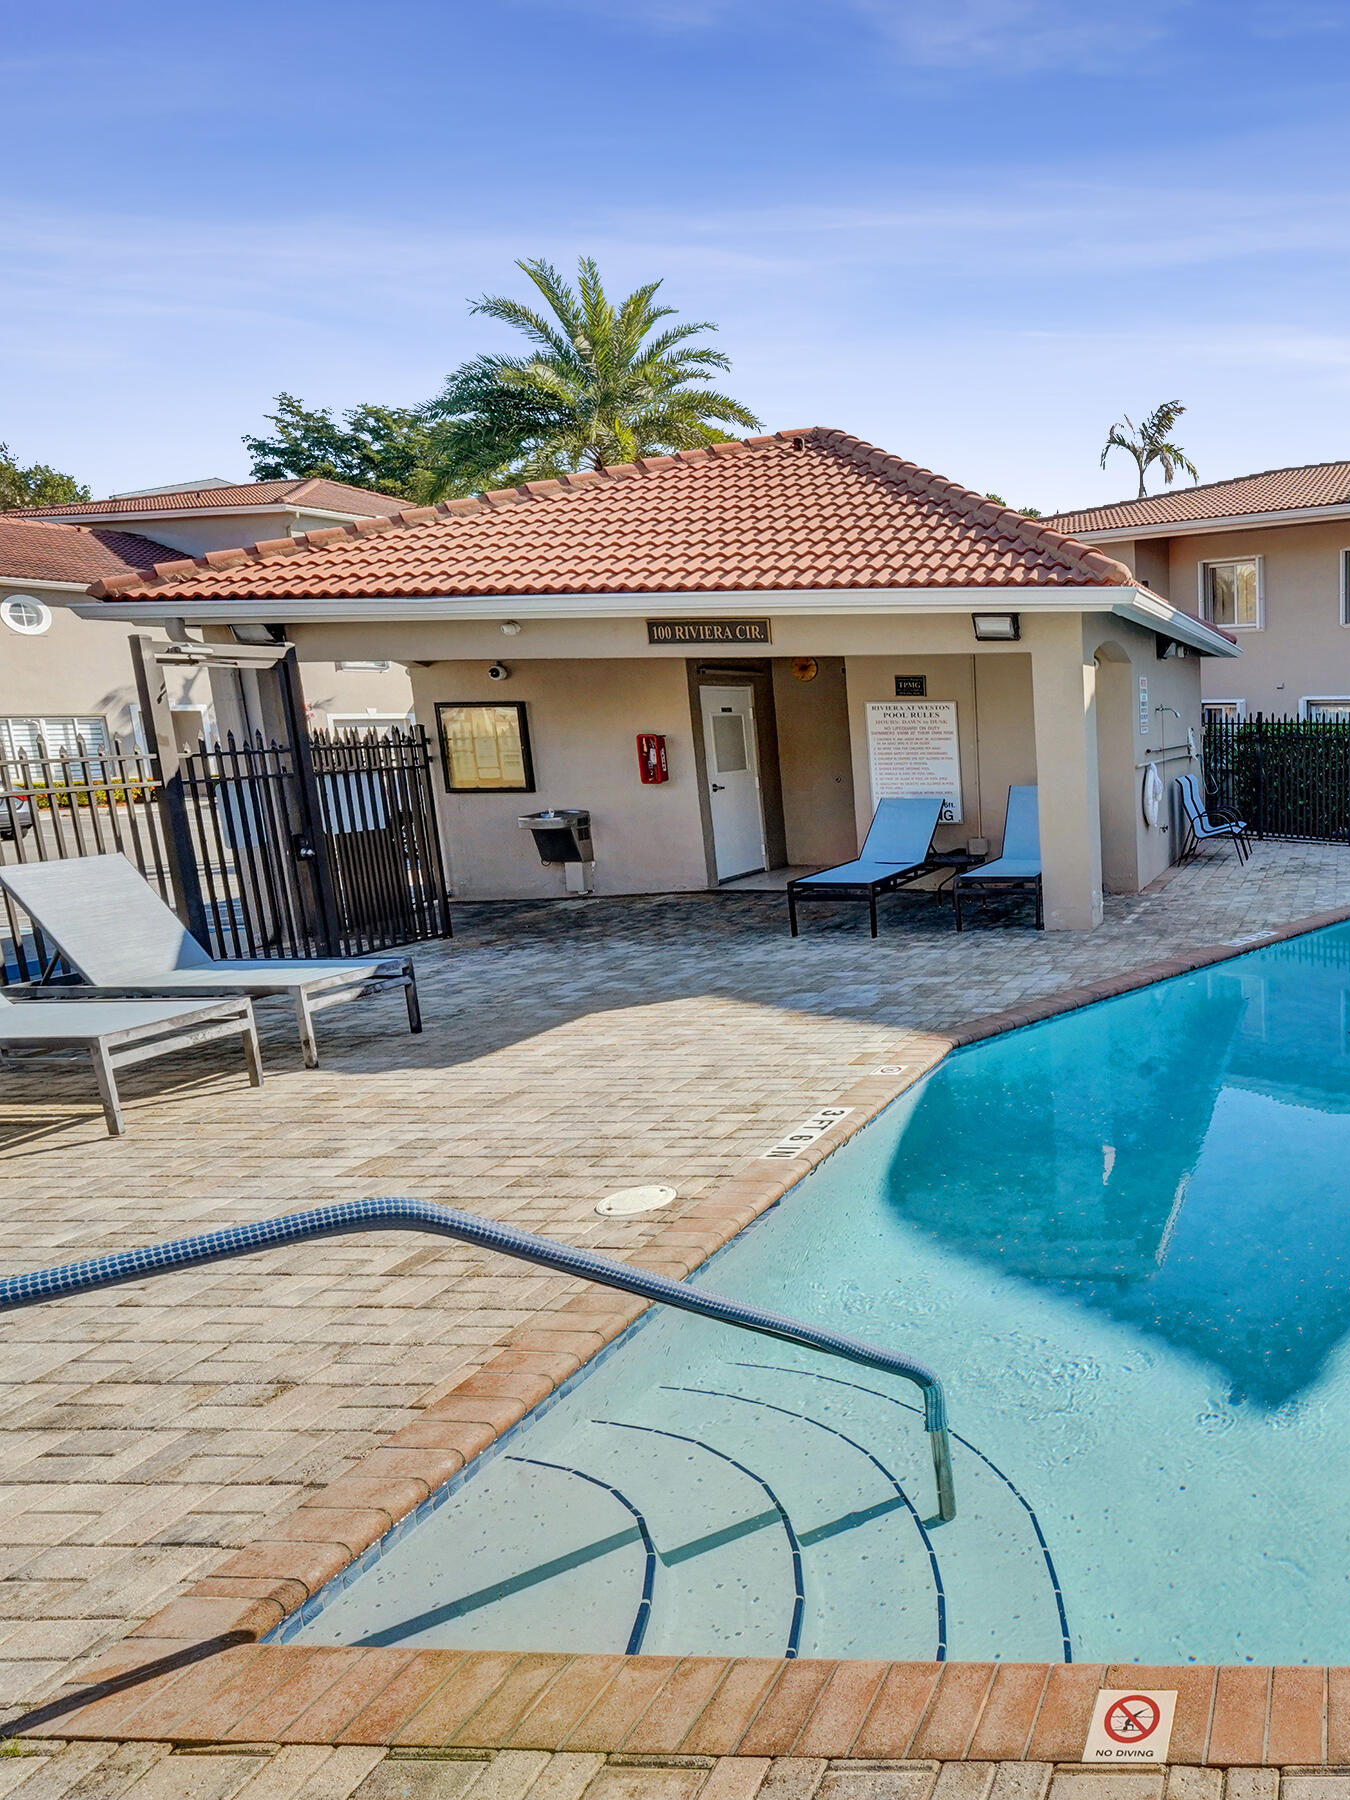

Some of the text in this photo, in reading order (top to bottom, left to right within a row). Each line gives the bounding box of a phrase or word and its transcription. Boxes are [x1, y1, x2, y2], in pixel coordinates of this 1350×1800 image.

[652, 625, 764, 639] 100 RIVIERA CIR.
[765, 1109, 845, 1158] 3 FT 6 IN
[1096, 1749, 1154, 1758] NO DIVING
